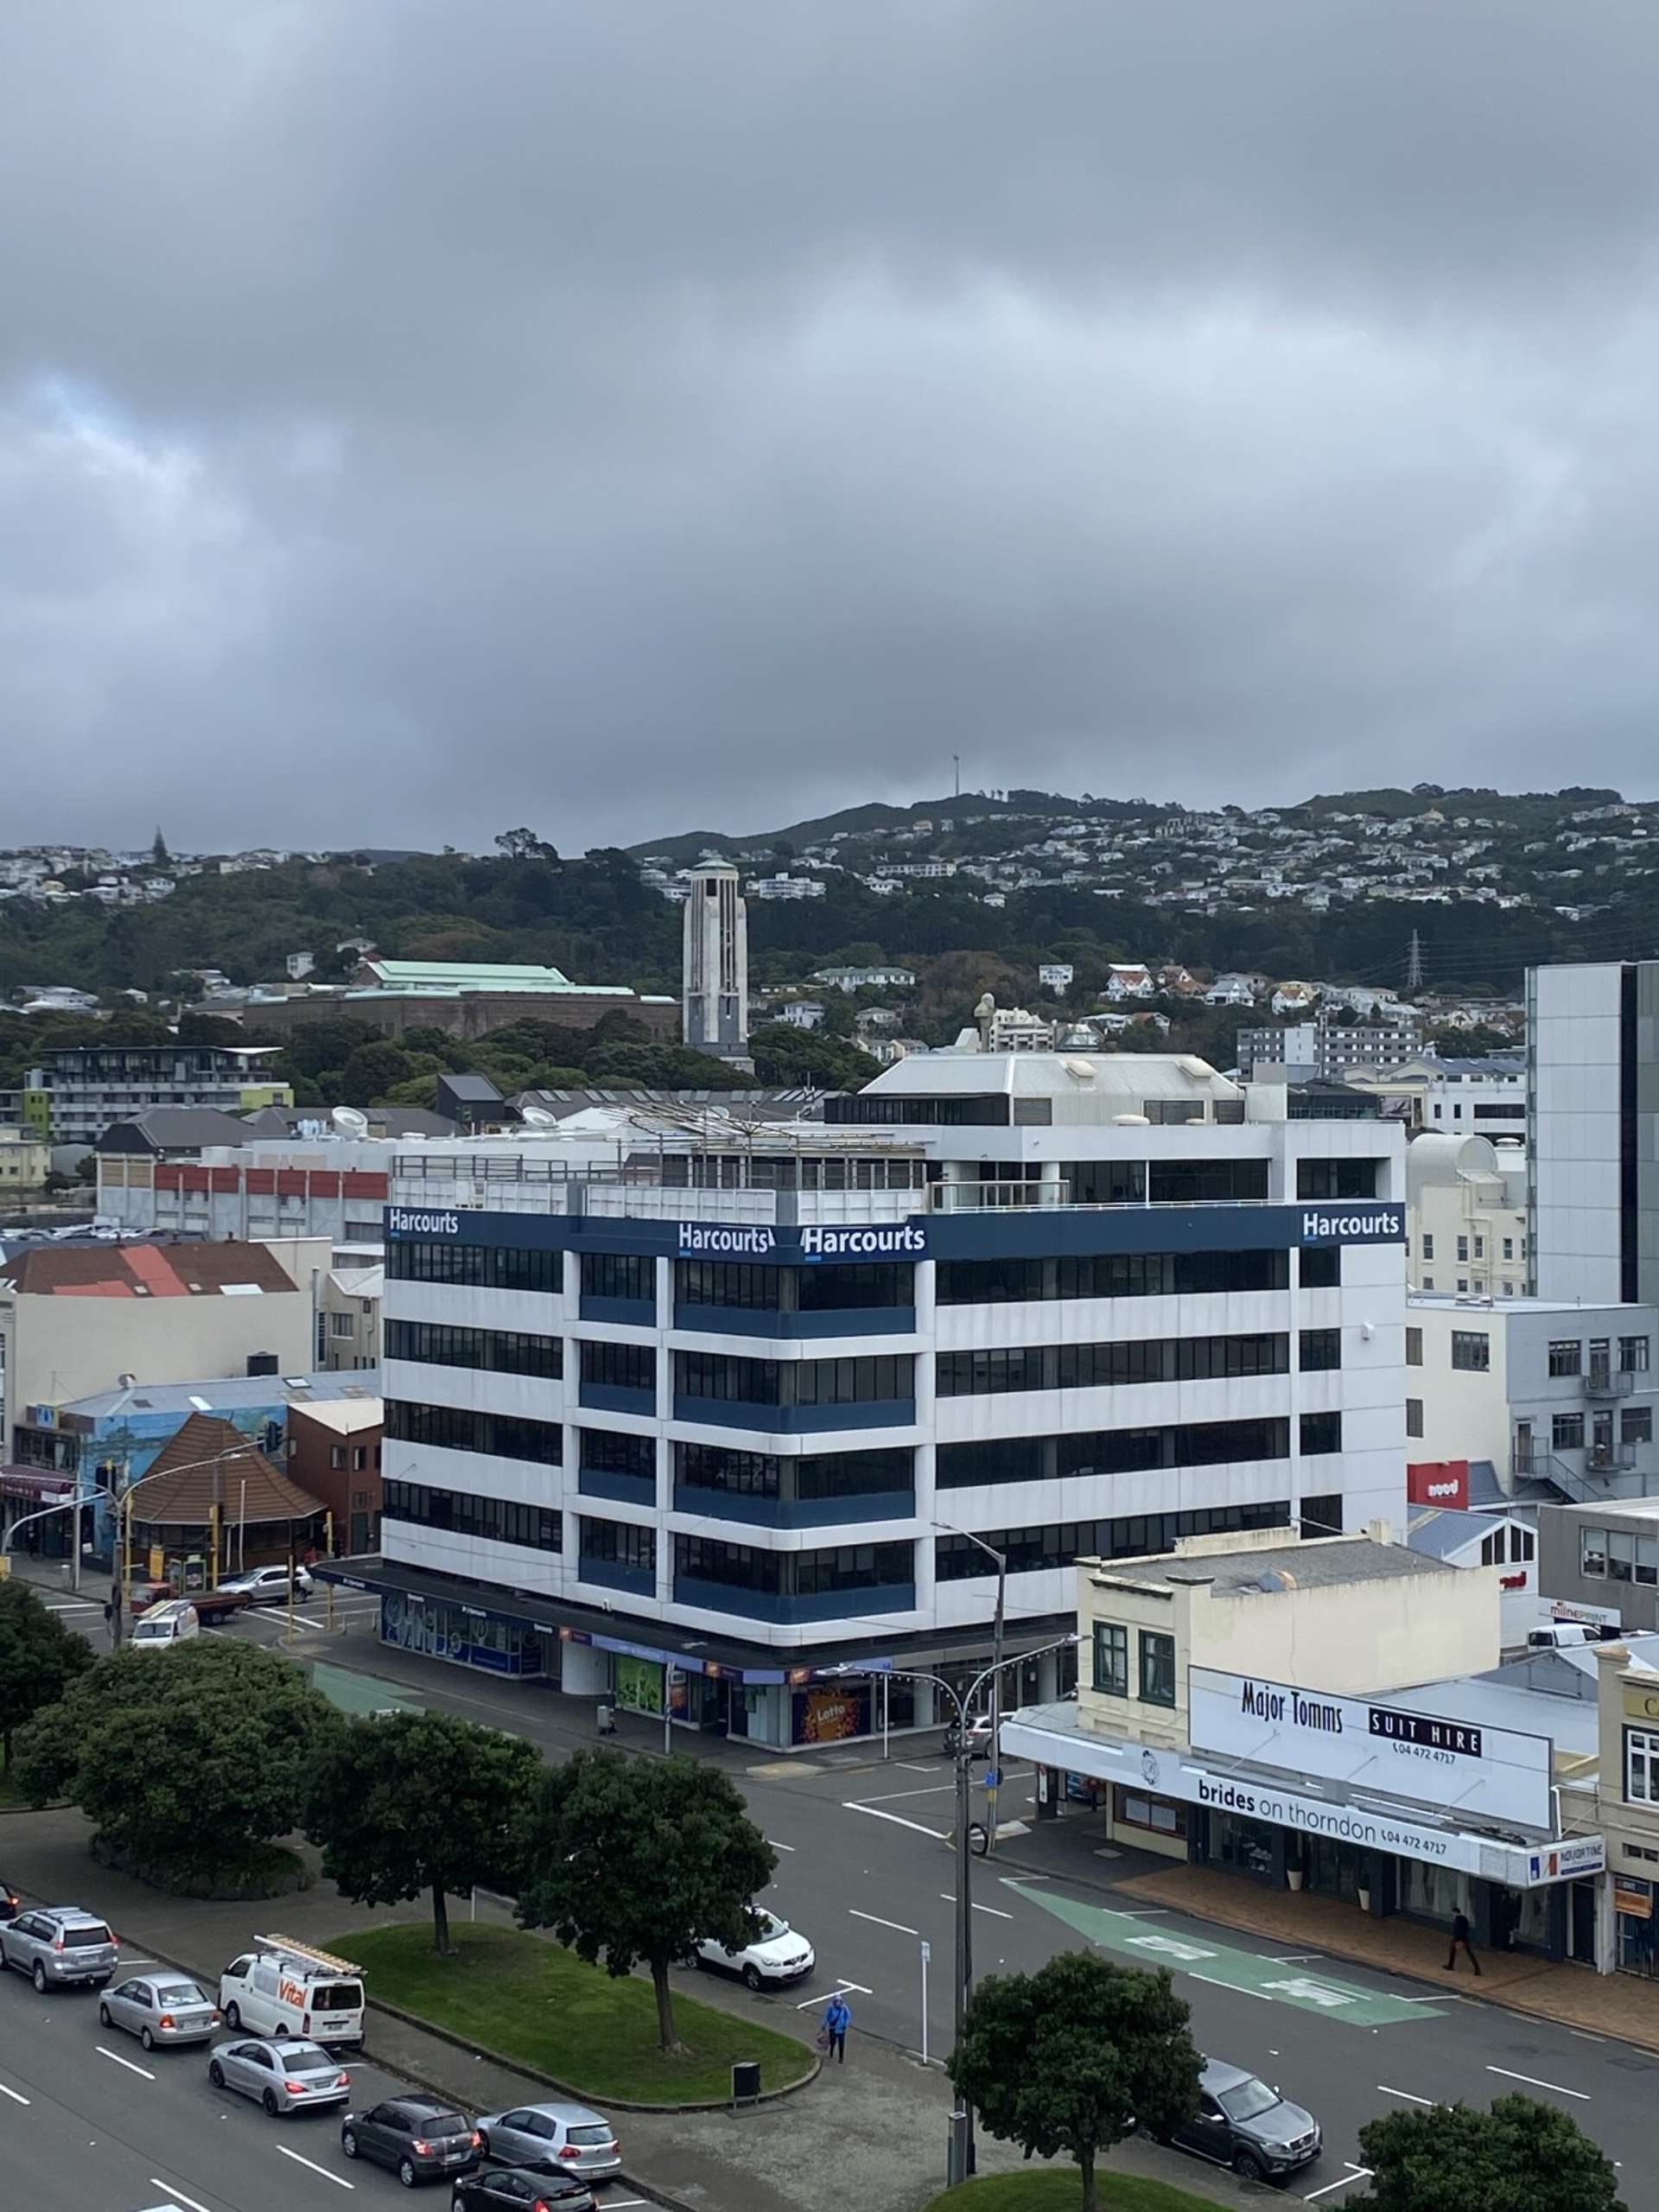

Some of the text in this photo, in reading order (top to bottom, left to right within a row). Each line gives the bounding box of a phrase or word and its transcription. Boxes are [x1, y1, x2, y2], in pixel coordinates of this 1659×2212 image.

[390, 1208, 459, 1234] Harcourts
[1303, 1211, 1400, 1236] Harcourts
[678, 1223, 769, 1253] Harcourts
[804, 1225, 925, 1254] Harcourts
[817, 1705, 846, 1723] Lotto
[1242, 1681, 1343, 1734] Major Tomms
[1372, 1713, 1478, 1752] SUIT HIRE
[1399, 1744, 1456, 1764] 04 472 4717
[1198, 1779, 1376, 1843] brides on thorndon
[1387, 1831, 1447, 1855] 04 472 4717
[279, 1979, 308, 2009] Vital
